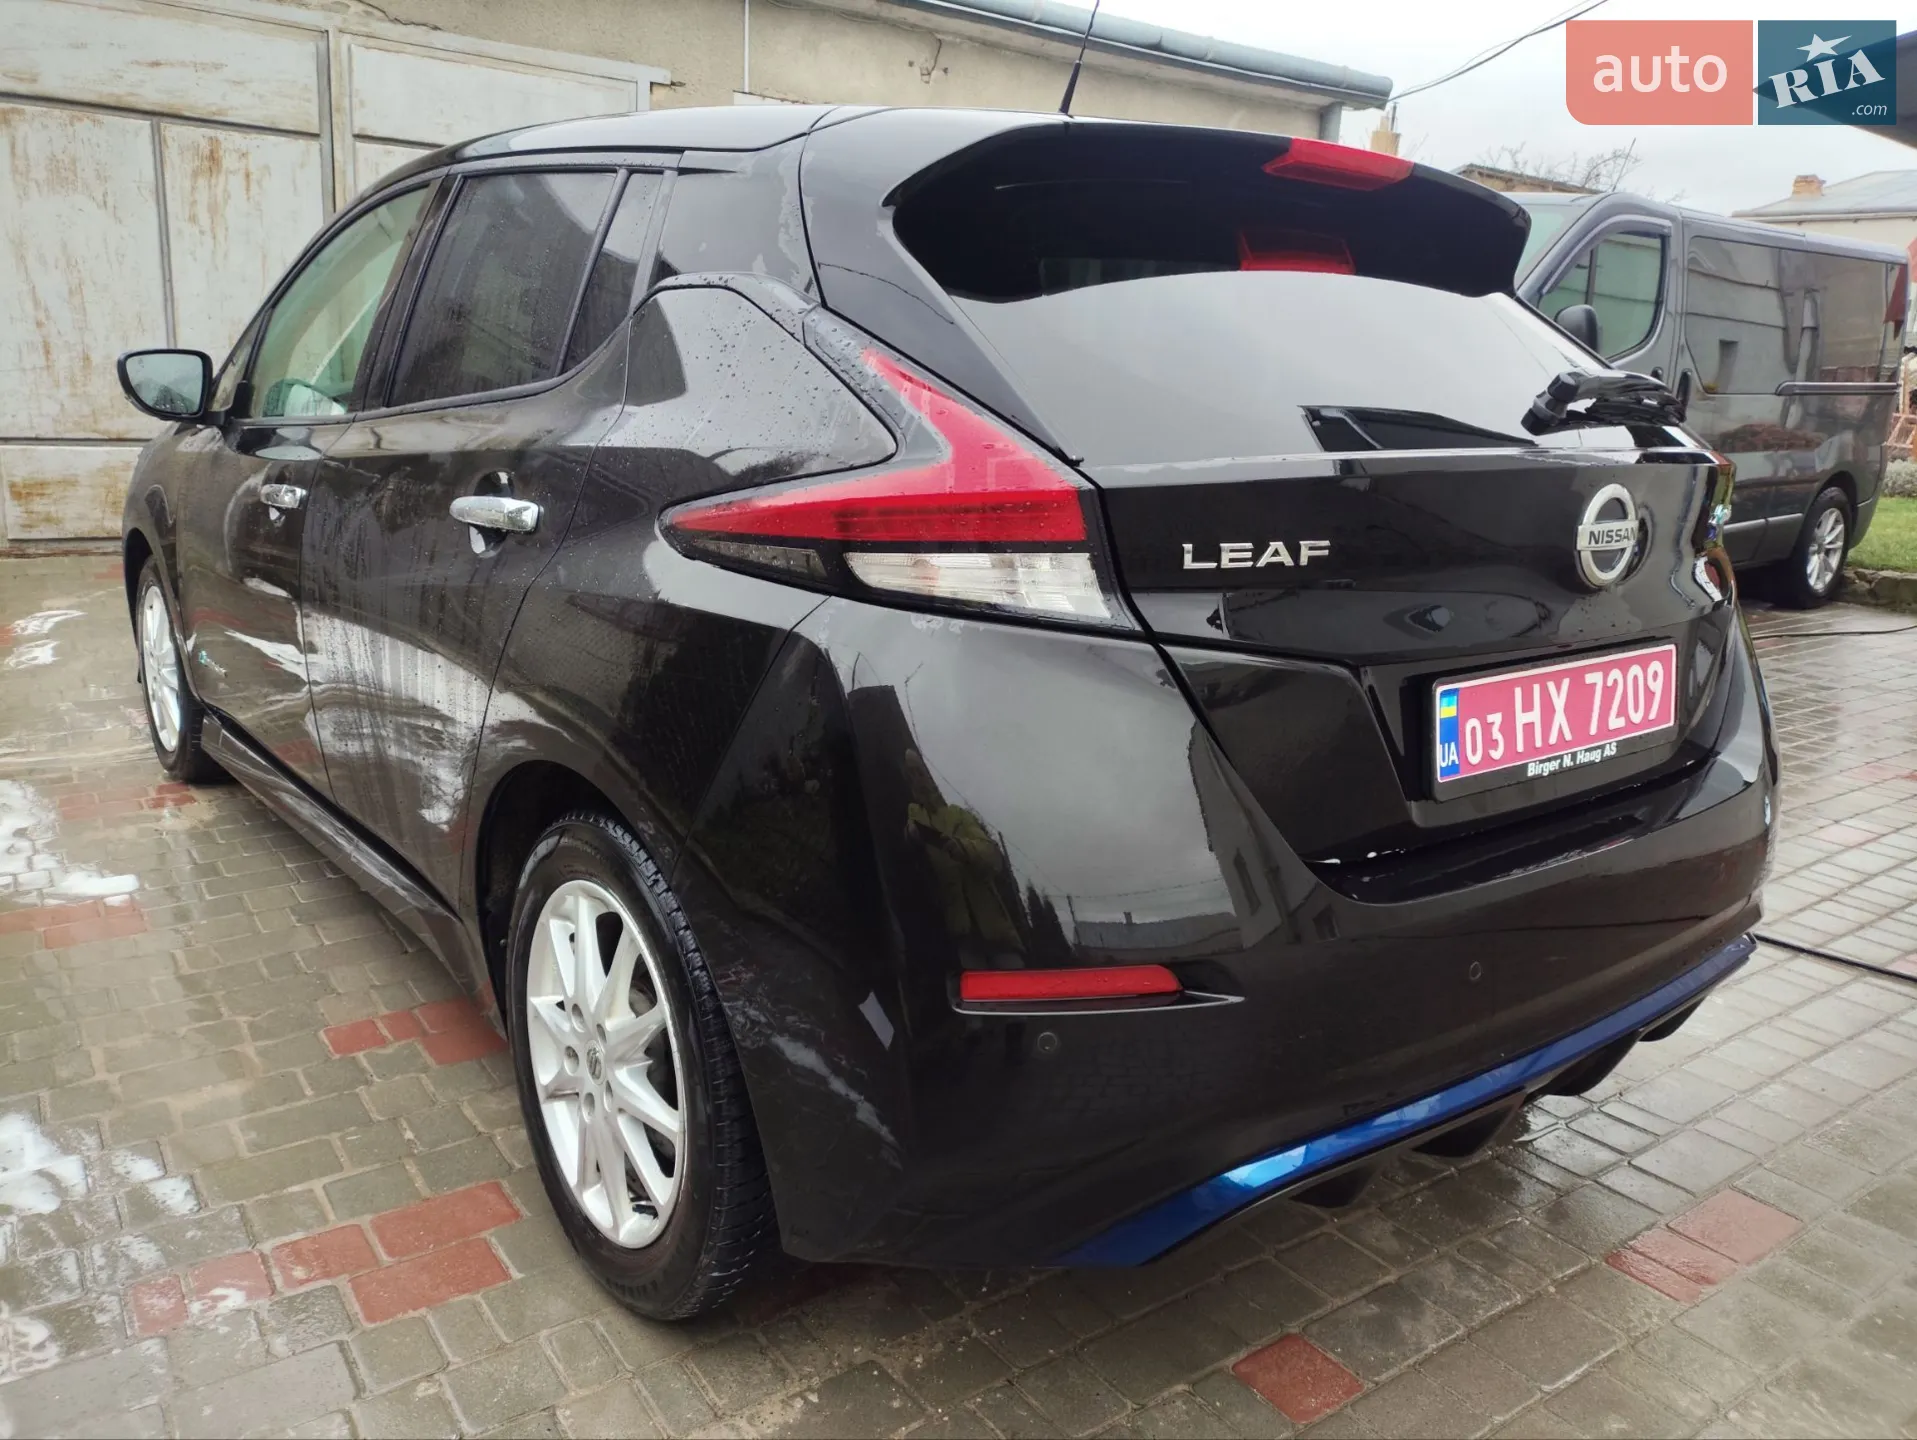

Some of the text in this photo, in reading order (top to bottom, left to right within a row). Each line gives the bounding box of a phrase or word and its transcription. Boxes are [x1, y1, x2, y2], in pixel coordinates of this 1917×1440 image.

[1588, 527, 1637, 545] NISSAN
[1182, 540, 1331, 570] LEAF
[1465, 660, 1664, 765] 03 HX 7209
[1440, 743, 1459, 767] UA
[1527, 741, 1618, 777] Birger N. Haug AS
